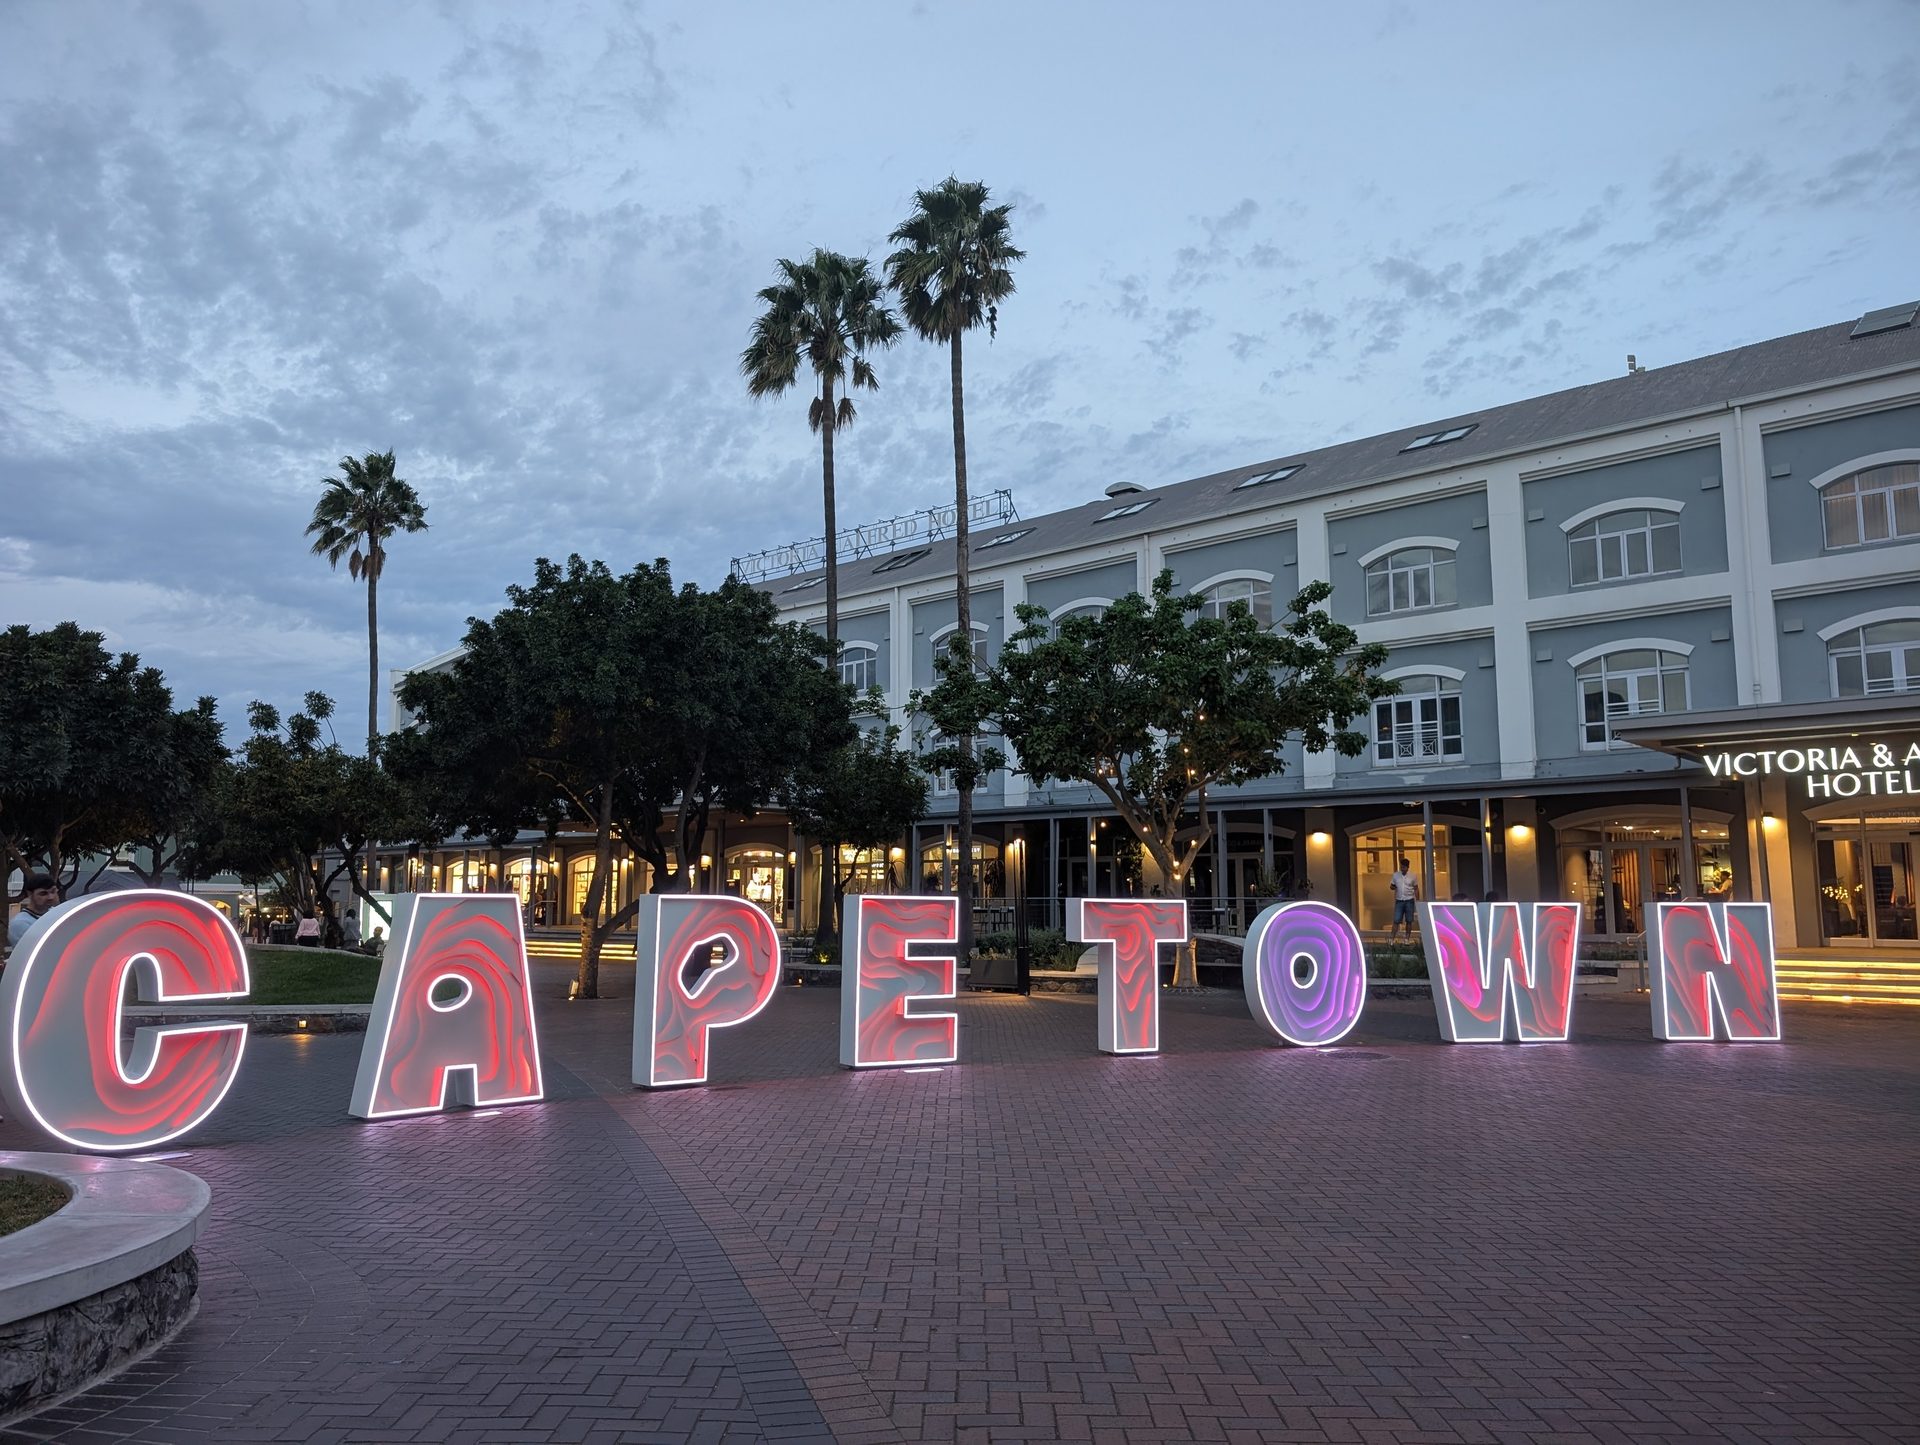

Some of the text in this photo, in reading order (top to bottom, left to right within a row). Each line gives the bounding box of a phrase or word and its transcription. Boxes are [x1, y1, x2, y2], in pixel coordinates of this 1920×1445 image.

[740, 545, 819, 574] VICTORIA
[928, 499, 998, 531] HOEL
[1703, 746, 1862, 777] VICTORIA
[1872, 743, 1895, 768] &
[1807, 770, 1920, 798] HOTEL
[1, 888, 1783, 1153] CAPE TOWN
